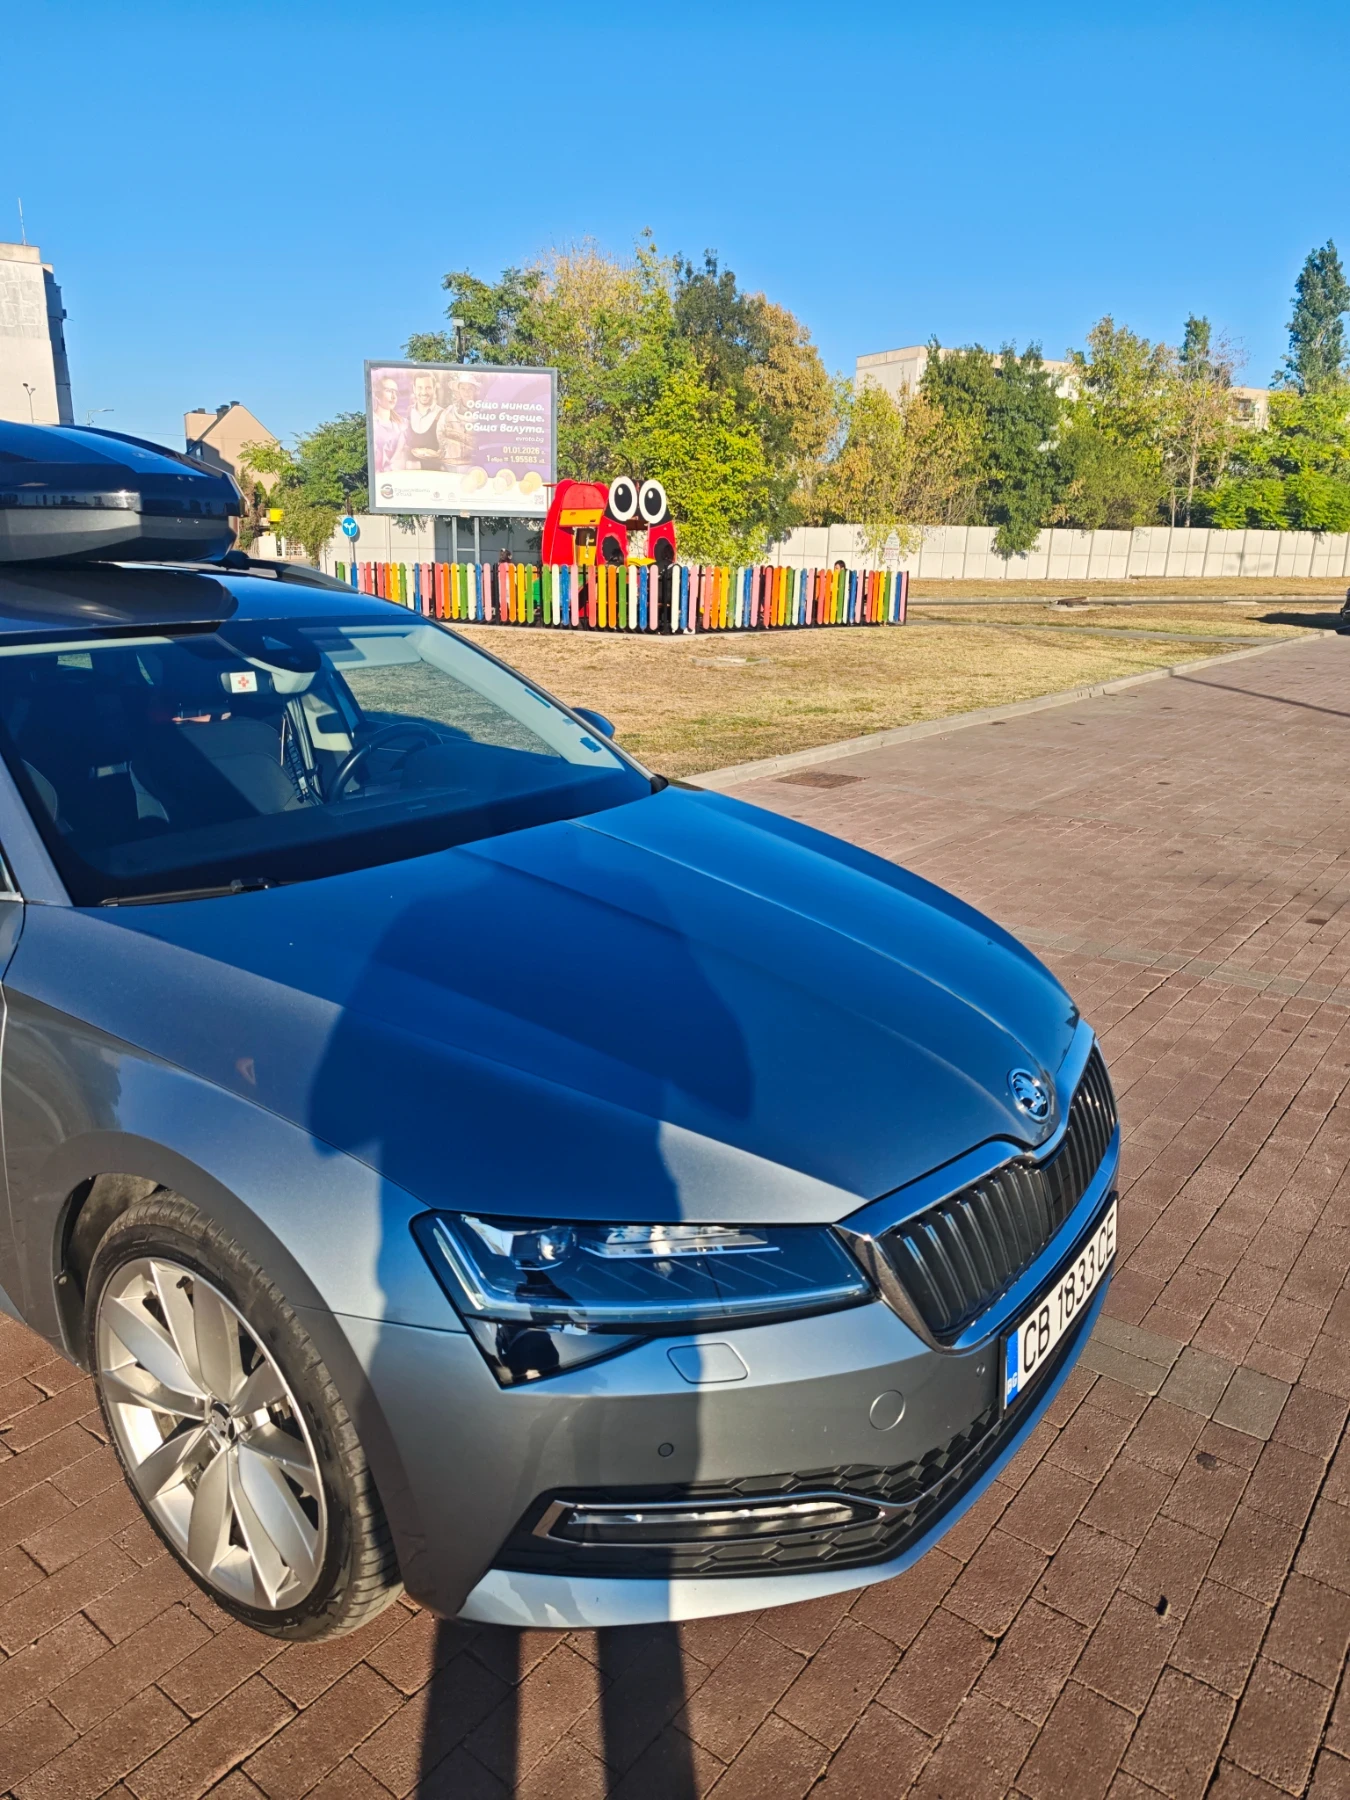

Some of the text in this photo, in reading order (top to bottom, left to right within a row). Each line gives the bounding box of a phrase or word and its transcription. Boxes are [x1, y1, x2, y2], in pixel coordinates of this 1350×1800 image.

[466, 399, 545, 411] Общо минало.
[463, 411, 545, 423] Общо бъдеще.
[464, 422, 545, 434] Обща валута.
[502, 446, 540, 455] 01.01.2026
[510, 456, 537, 464] 1.95583
[1023, 1211, 1115, 1375] CB 1833 CE
[1006, 1371, 1018, 1394] BG
